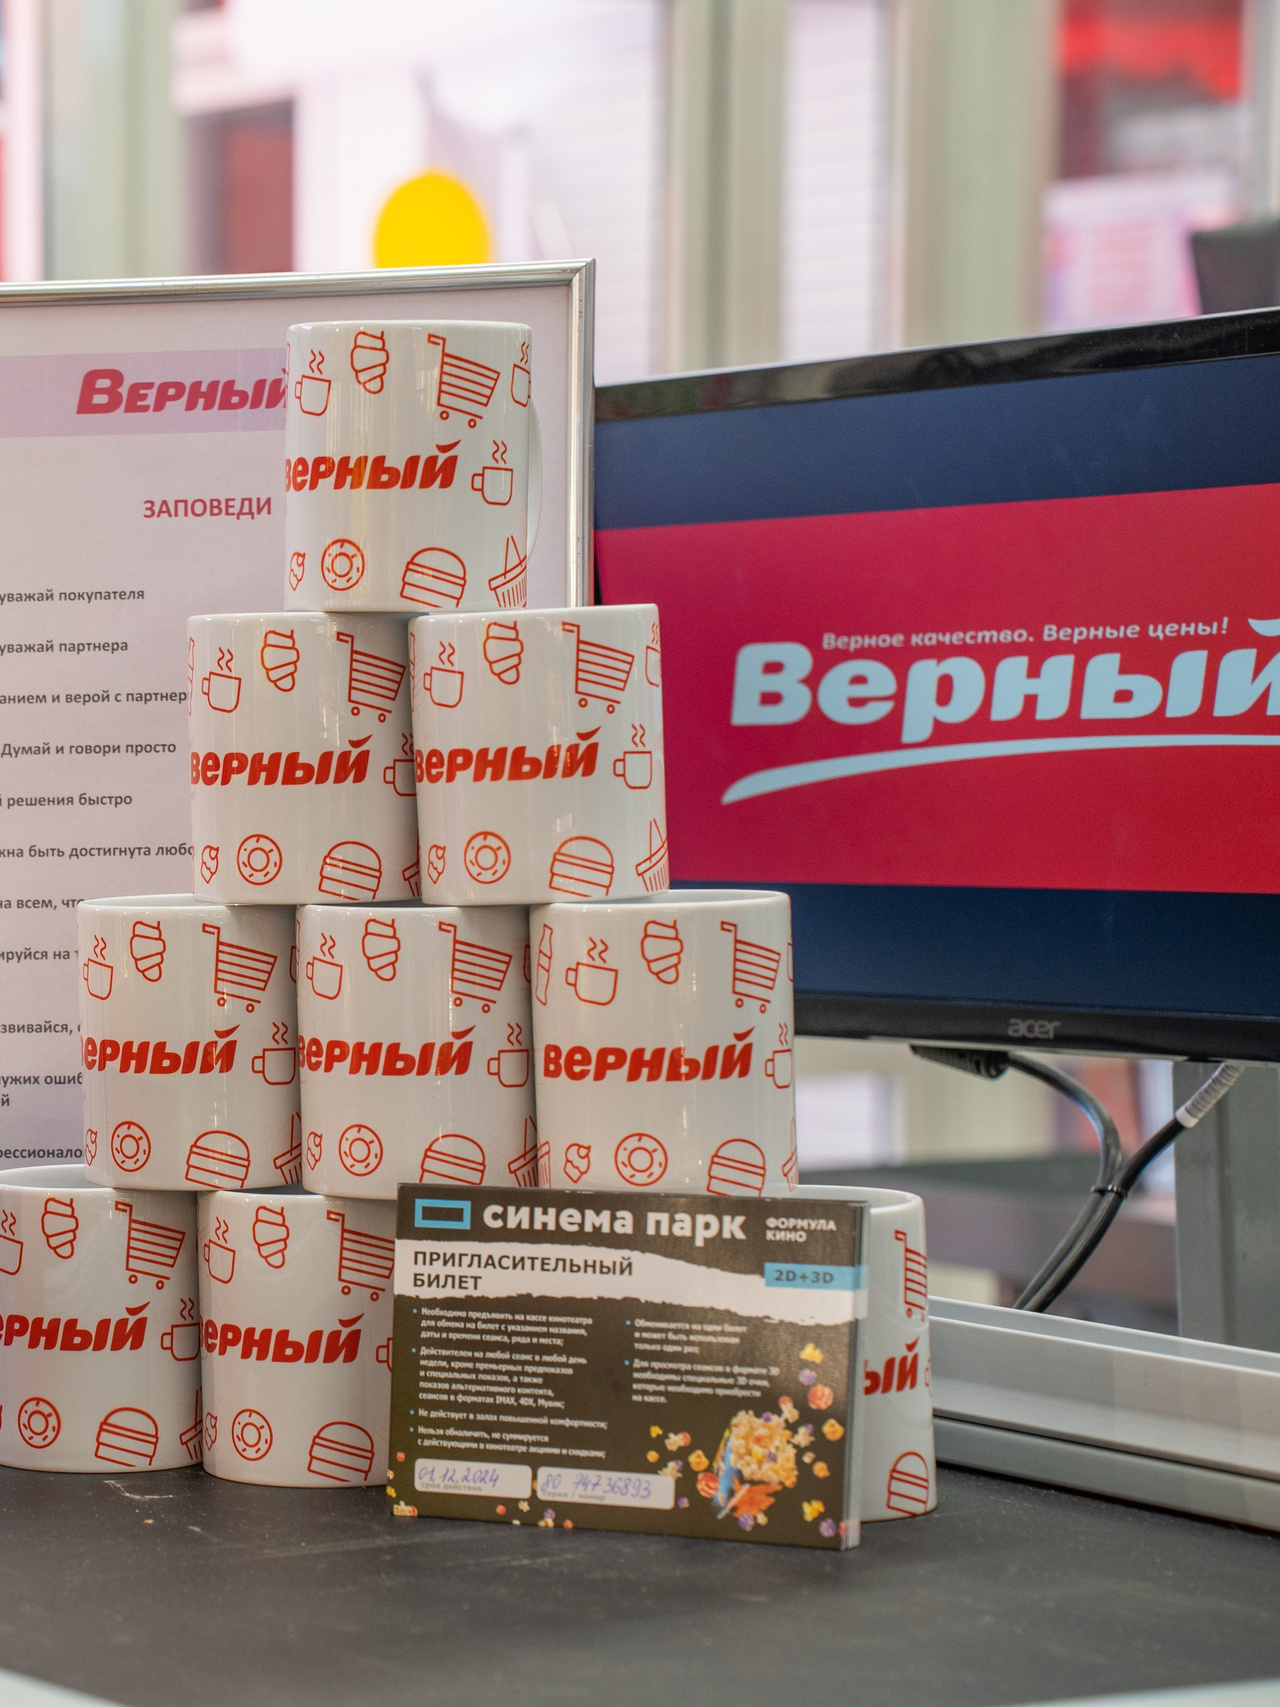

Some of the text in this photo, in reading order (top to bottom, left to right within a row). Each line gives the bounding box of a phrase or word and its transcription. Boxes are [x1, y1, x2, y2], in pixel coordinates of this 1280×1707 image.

[143, 496, 272, 521] ЗАПОВЕДИ
[58, 590, 145, 604] покупателя
[822, 617, 1228, 650] Верное качество. Верные цены!
[58, 641, 129, 656] партнера
[51, 693, 61, 704] и
[65, 689, 111, 707] верой
[114, 692, 122, 703] с
[0, 741, 51, 759] Думай
[55, 745, 65, 755] и
[68, 744, 121, 758] говори
[125, 743, 177, 757] просто
[6, 796, 75, 810] решения
[78, 792, 133, 809] быстро
[28, 844, 66, 858] быть
[68, 846, 152, 860] достигнута
[16, 898, 58, 911] всем,
[52, 950, 71, 961] на
[1007, 1018, 1061, 1040] acer
[81, 1024, 240, 1074] ерный
[483, 1204, 747, 1246] синема парк
[765, 1217, 837, 1231] ФОРМУЛА
[765, 1229, 807, 1243] КИНО
[413, 1251, 633, 1276] ПРИГЛАСИТЕЛЬНЫЙ
[413, 1273, 482, 1291] БИЛЕТ
[774, 1269, 835, 1284] 2D+3D
[200, 1313, 365, 1363] ерный
